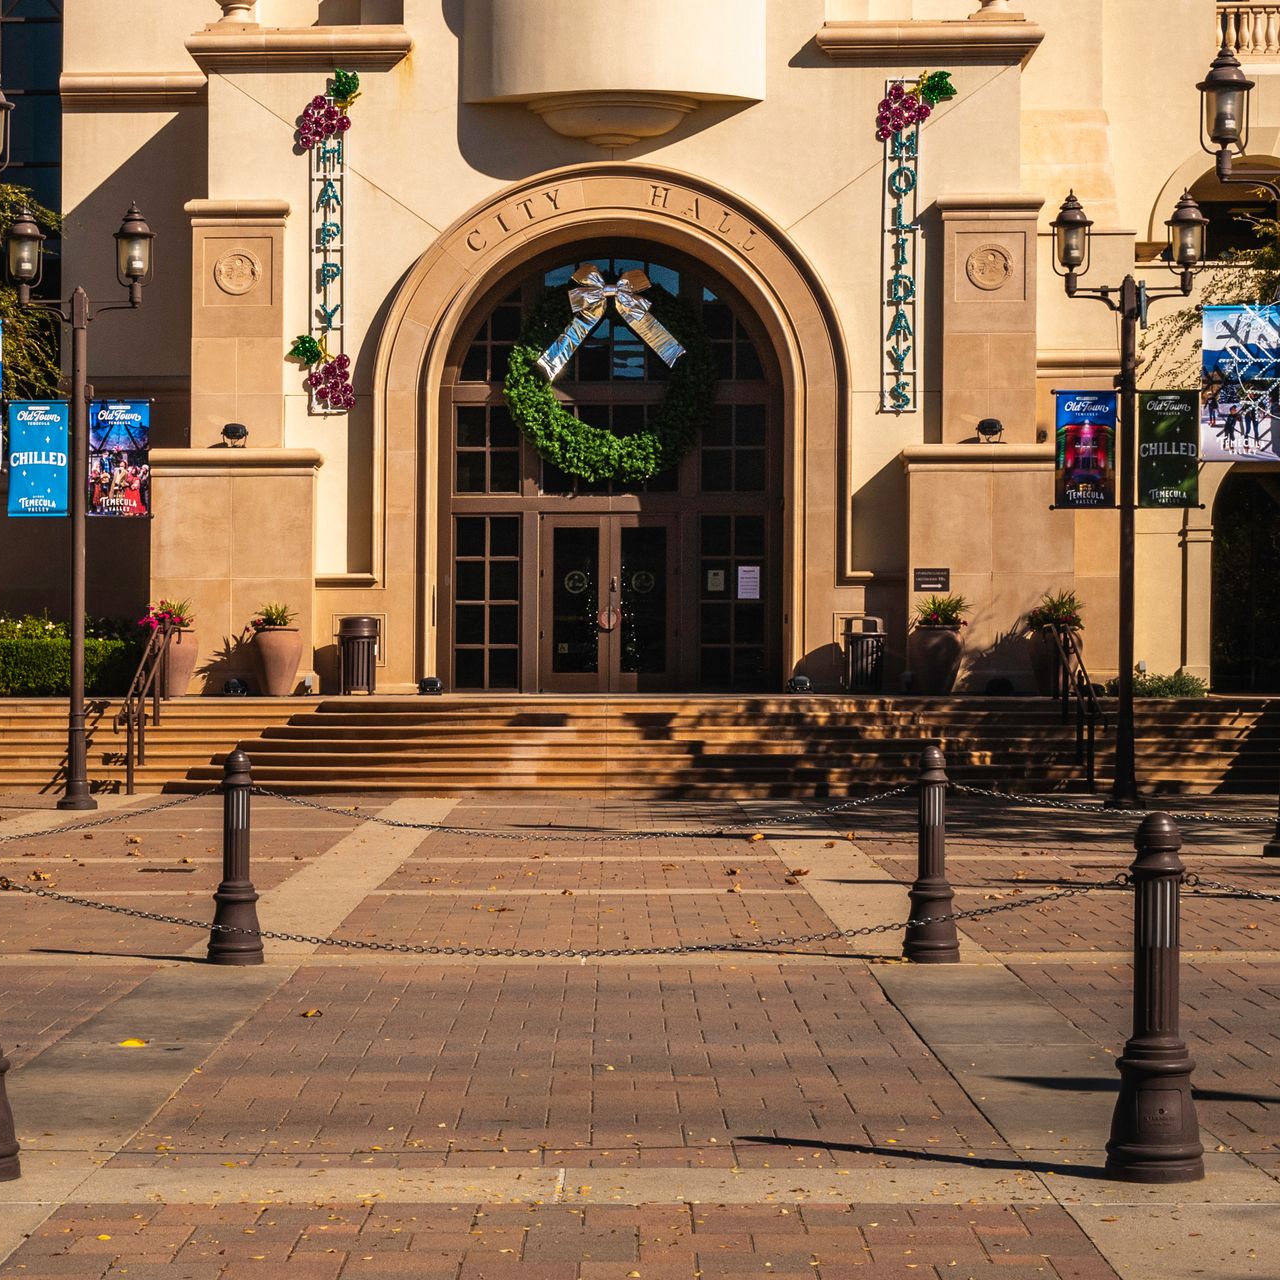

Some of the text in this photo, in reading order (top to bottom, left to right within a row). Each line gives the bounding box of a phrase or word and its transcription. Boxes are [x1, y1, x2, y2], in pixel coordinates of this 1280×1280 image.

[464, 183, 758, 254] CITY HALL
[320, 139, 342, 331] HAPPY
[889, 130, 918, 410] HOLIDAYS
[1064, 401, 1110, 413] Old Town
[1146, 400, 1191, 412] Old Town
[16, 410, 61, 423] Old Town
[97, 409, 142, 422] Old Town
[1140, 442, 1197, 458] CHILLED
[10, 451, 67, 467] CHILLED
[1066, 489, 1105, 501] TEMECULA
[1148, 488, 1187, 500] TEMECULA
[18, 497, 57, 509] TEMECULA
[99, 496, 138, 508] TEMECULA
